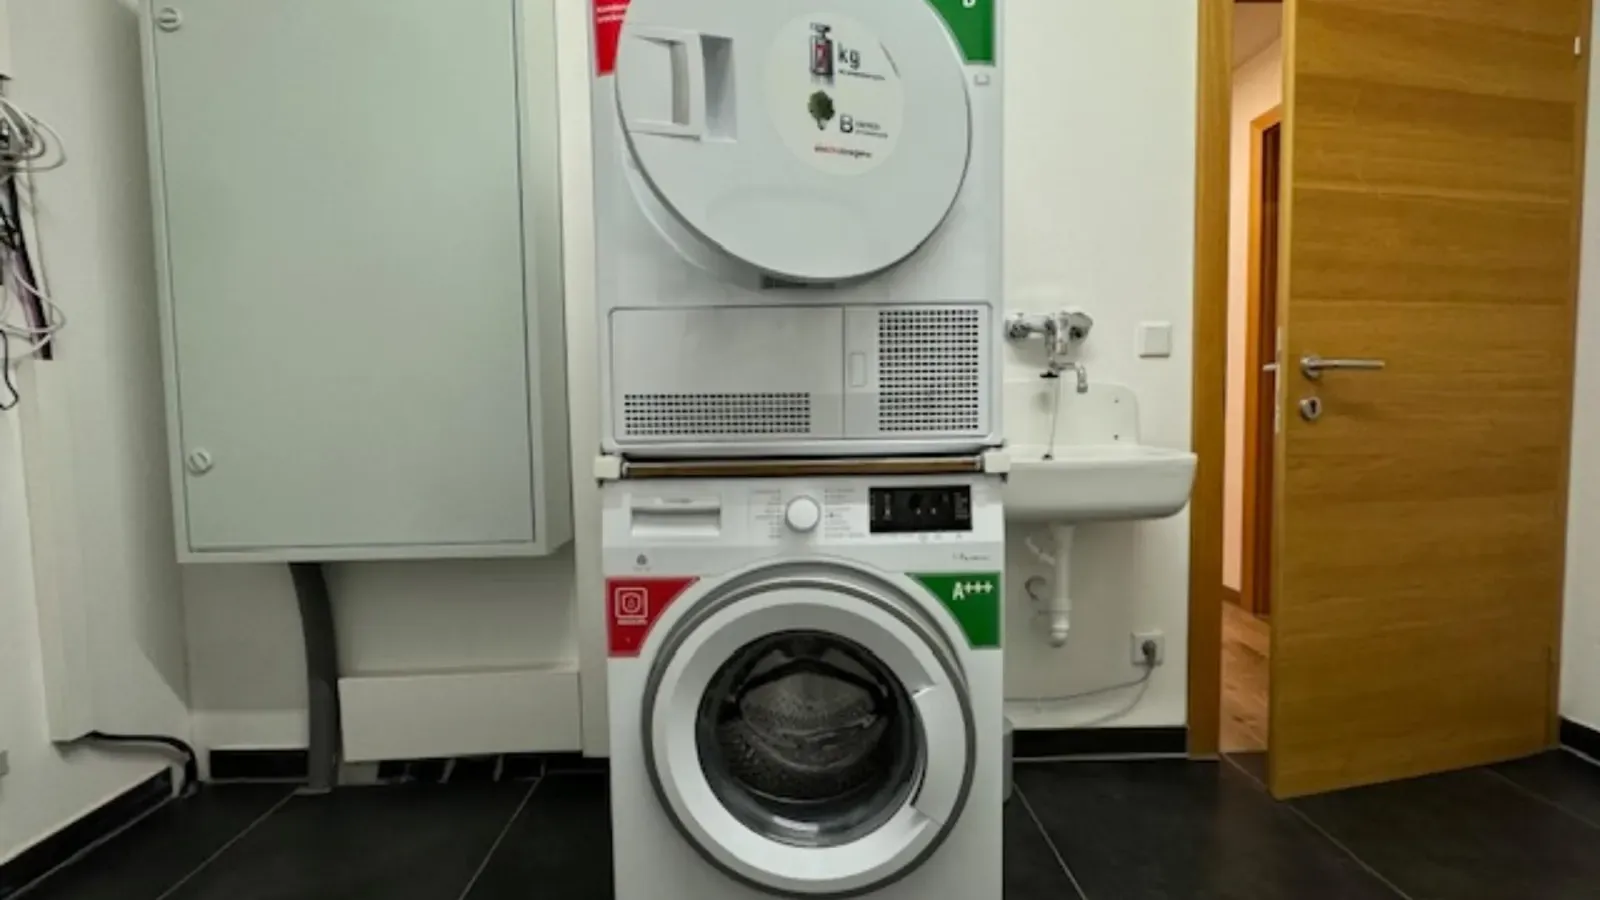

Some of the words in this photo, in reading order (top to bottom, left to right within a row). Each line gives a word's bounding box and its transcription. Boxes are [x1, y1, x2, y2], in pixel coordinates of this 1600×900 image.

[838, 42, 861, 70] kg
[840, 114, 853, 133] B
[952, 580, 994, 600] A+++
